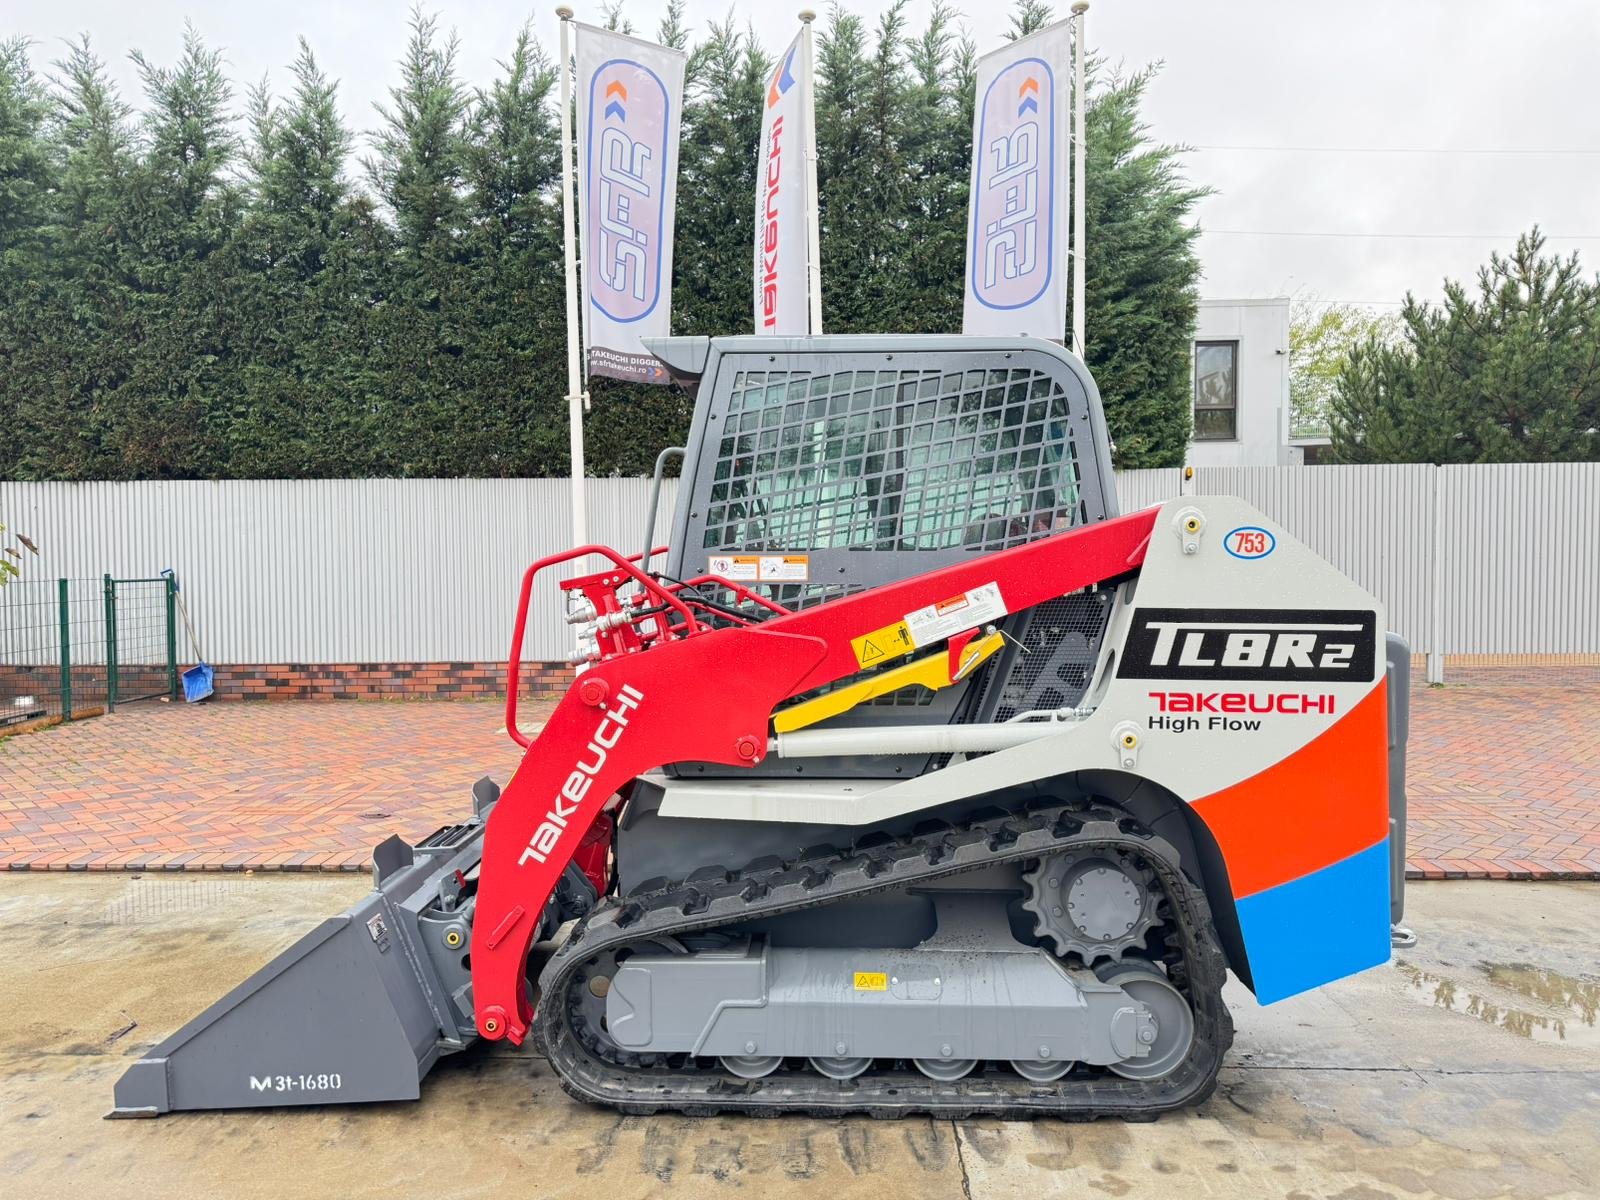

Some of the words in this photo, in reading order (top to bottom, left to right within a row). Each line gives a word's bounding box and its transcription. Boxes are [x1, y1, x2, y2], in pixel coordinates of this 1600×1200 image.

[600, 126, 652, 301] SFR
[591, 350, 629, 363] TAKEUCHI
[1235, 533, 1265, 553] 753
[1146, 622, 1363, 669] TL8R2
[1149, 692, 1335, 714] TAKEUCHI
[1148, 716, 1200, 733] High
[1208, 717, 1262, 731] Flow
[518, 684, 644, 866] TAKEUCHI
[275, 1073, 342, 1092] 3t-1680
